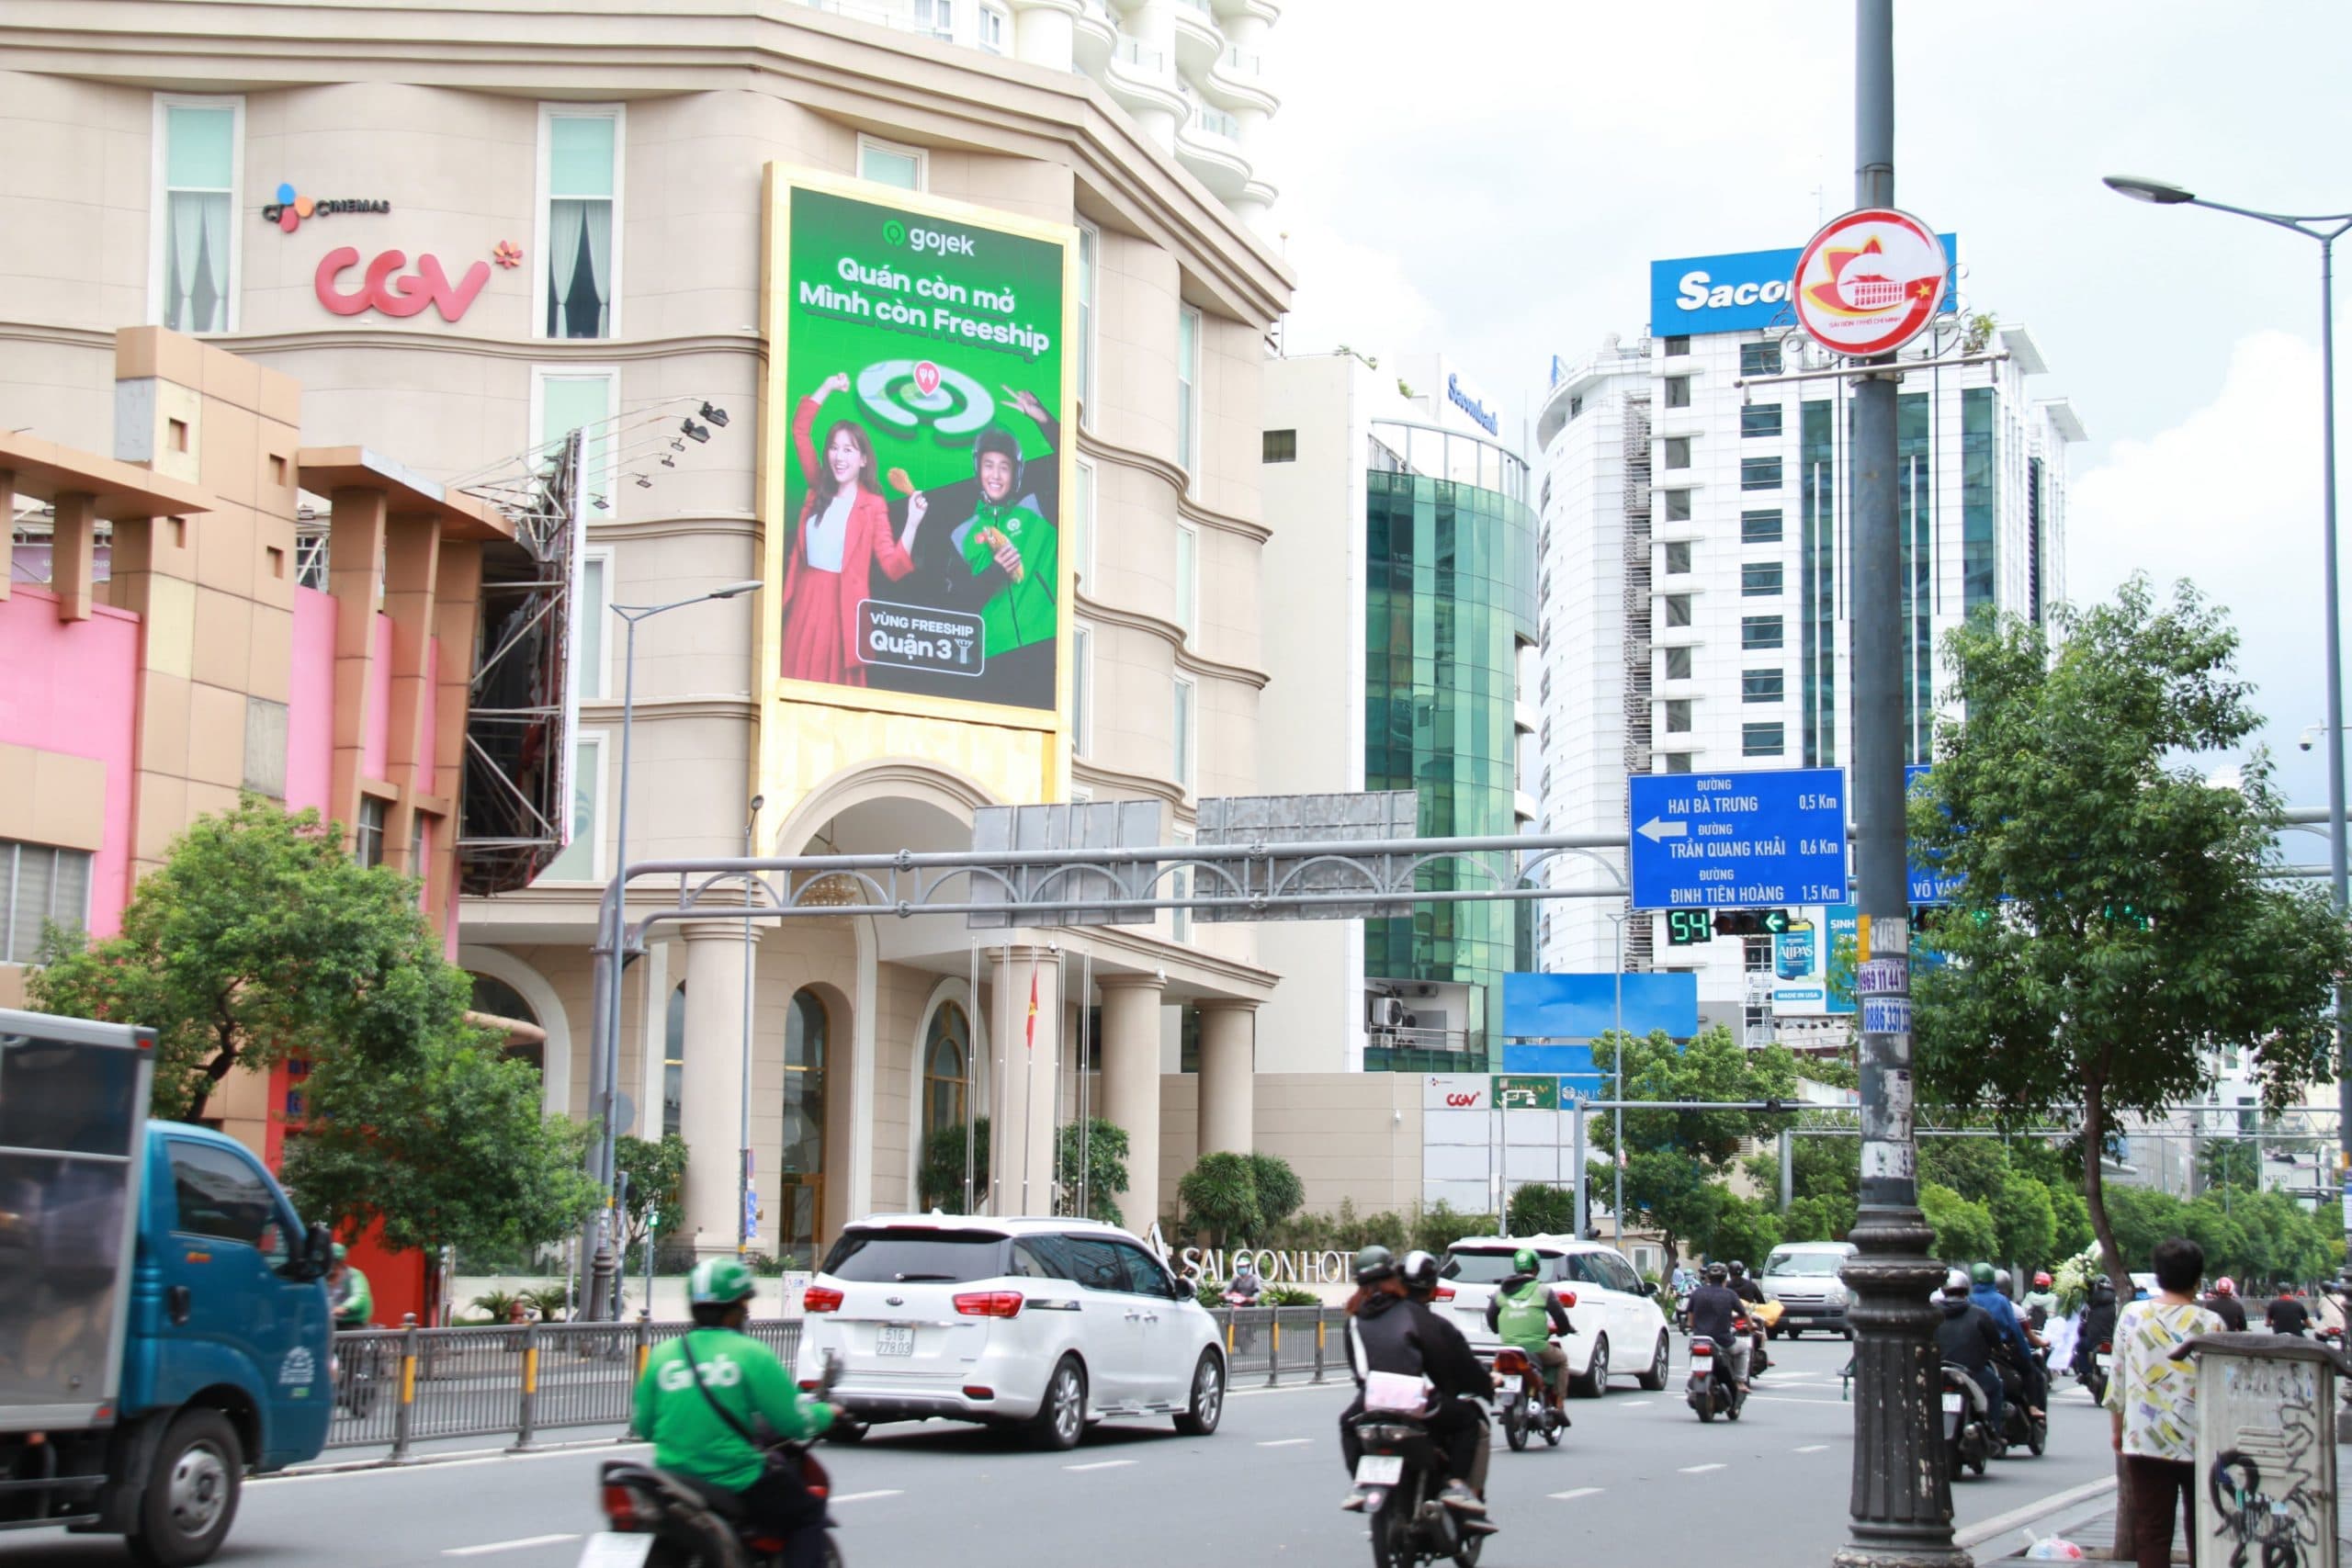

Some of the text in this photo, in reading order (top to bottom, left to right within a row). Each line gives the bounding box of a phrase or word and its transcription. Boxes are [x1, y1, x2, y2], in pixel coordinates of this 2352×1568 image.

[315, 199, 390, 217] CINEMAS
[910, 227, 975, 256] gojek
[314, 246, 491, 322] CGV
[837, 257, 1015, 313] Quán còn mở
[799, 281, 1049, 355] Mình còn Freeship
[870, 612, 974, 637] VÙNG FREESHIP
[870, 629, 953, 660] Quận 3
[1697, 779, 1732, 791] ĐƯỜNG
[1668, 798, 1690, 814] HAI
[1693, 795, 1711, 814] BÀ
[1713, 796, 1758, 812] TRƯNG
[1818, 794, 1838, 809] Km
[1698, 821, 1733, 835] ĐƯỜNG
[1669, 838, 1703, 858] TRẦN
[1707, 841, 1750, 857] QUANG
[1755, 836, 1786, 856] KHẢI
[1820, 839, 1838, 854] Km
[1699, 866, 1735, 881] ĐƯỜNG
[1670, 888, 1702, 904] ĐINH
[1705, 884, 1736, 902] TIÊN
[1739, 883, 1784, 901] HOÀNG
[1821, 885, 1839, 900] Km
[1671, 911, 1707, 941] 54
[1830, 919, 1855, 929] SINH
[1446, 1093, 1476, 1107] CGV
[1301, 1250, 1360, 1283] HOT
[658, 1354, 741, 1392] Gab
